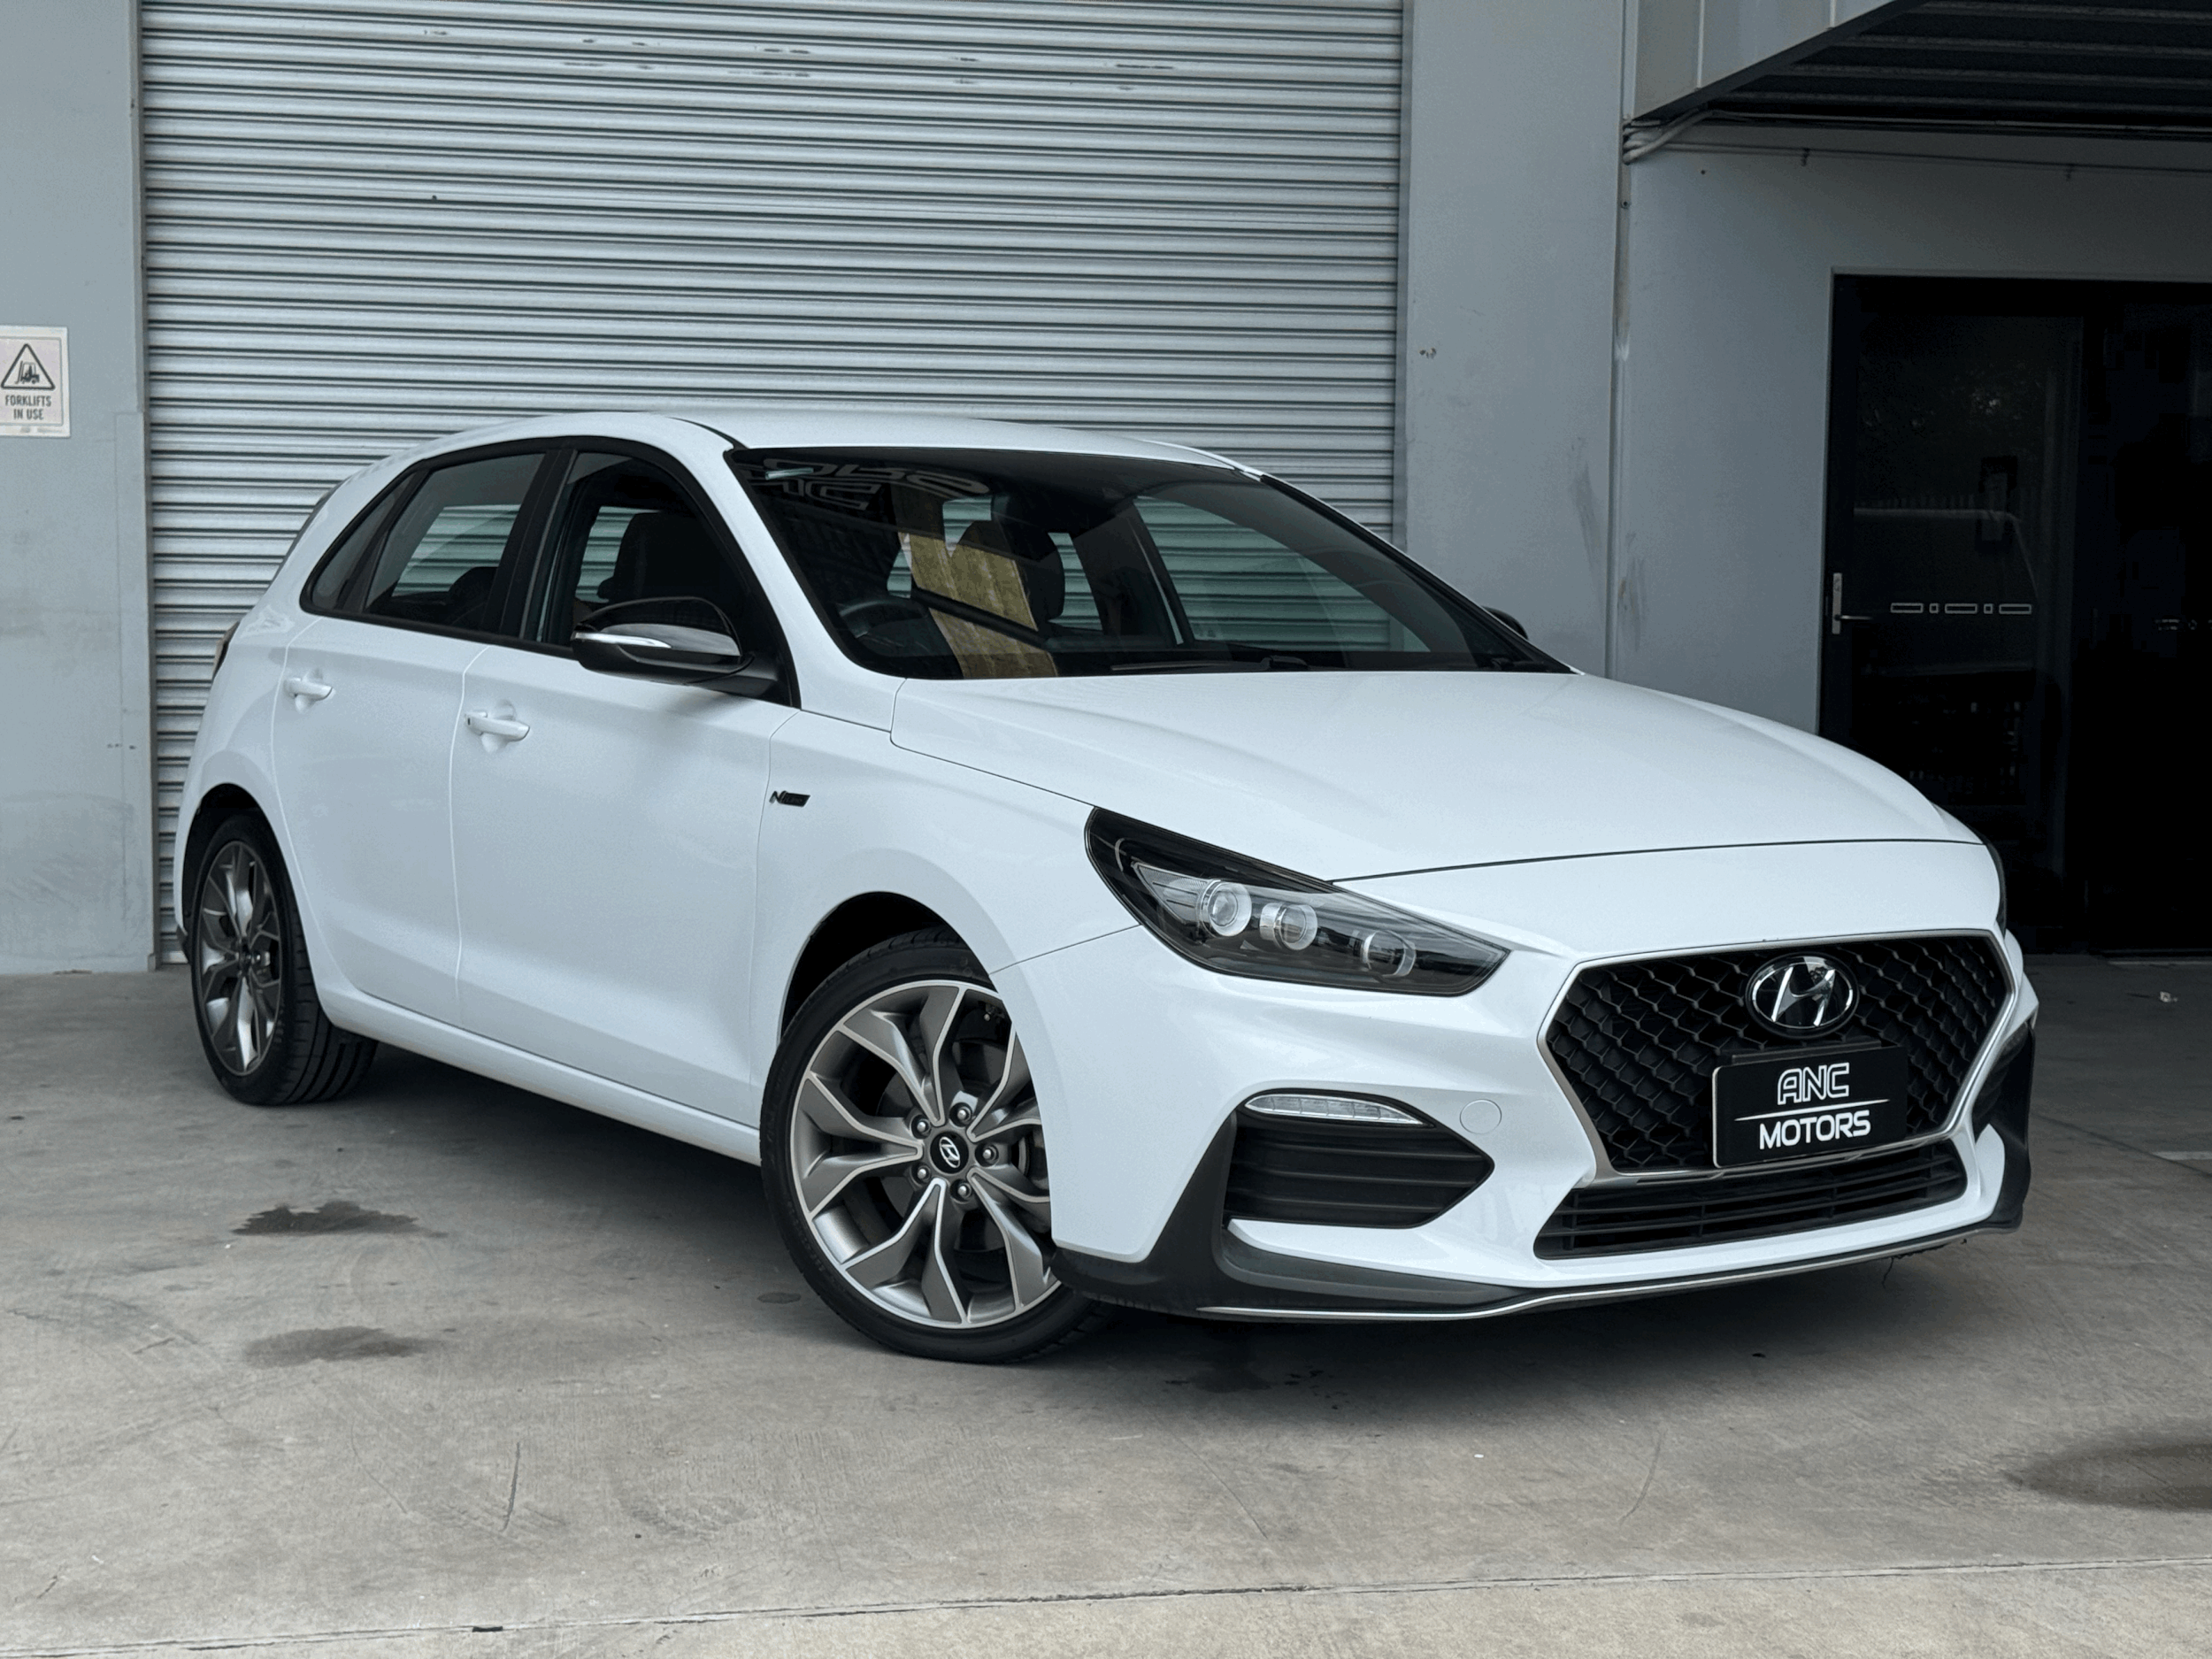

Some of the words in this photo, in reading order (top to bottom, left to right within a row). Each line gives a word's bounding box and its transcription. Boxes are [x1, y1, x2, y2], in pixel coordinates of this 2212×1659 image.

[4, 395, 51, 407] FORKLIFTS
[13, 409, 24, 419] IN
[27, 409, 44, 420] USE
[1778, 1062, 1850, 1105] ANC
[1759, 1110, 1871, 1150] MOTORS
